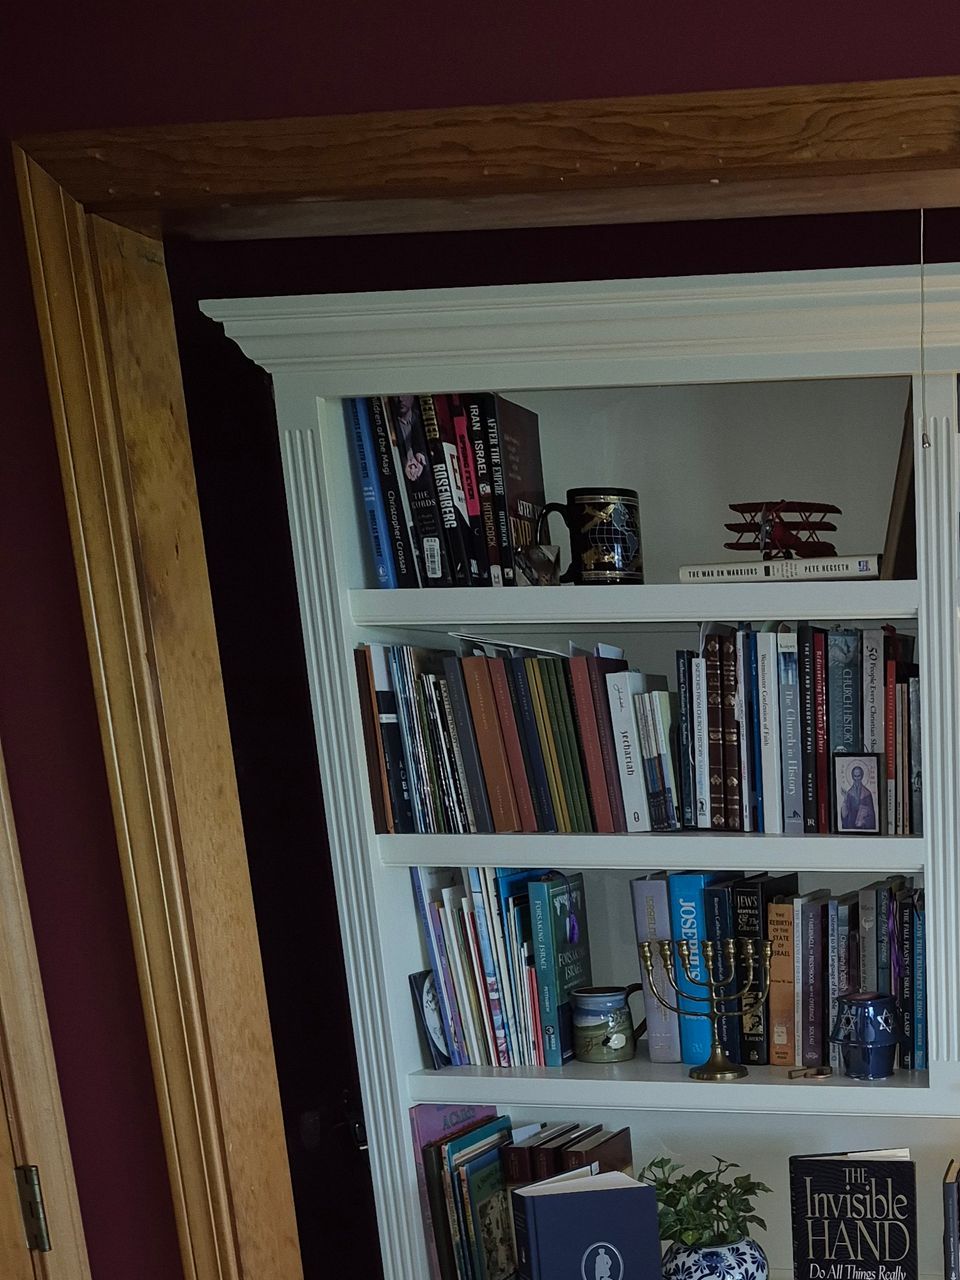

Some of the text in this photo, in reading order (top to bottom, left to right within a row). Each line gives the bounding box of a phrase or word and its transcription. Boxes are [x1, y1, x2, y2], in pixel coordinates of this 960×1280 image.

[469, 405, 487, 477] IRAN ISRAEL
[486, 416, 504, 496] AFTER THE EMPIRE
[432, 463, 457, 529] ROSENBERG
[387, 491, 407, 574] Christopher Crossan
[483, 502, 495, 548] HITCHCOCK
[702, 570, 714, 578] WAR
[726, 568, 758, 577] WARRIORS
[804, 565, 820, 573] PETE
[822, 563, 849, 572] HEGSETH
[760, 654, 770, 747] Westminster Confession of Faith
[815, 651, 825, 753] Rediscovering Church Fathers
[842, 669, 854, 745] CHURCH HISTORY
[866, 646, 878, 736] 50 People Every Christian
[785, 690, 800, 796] The Church in History
[714, 916, 722, 939] Catholics
[737, 895, 757, 907] JEWS
[534, 900, 547, 970] FORSAKING ISRAEL
[773, 934, 789, 942] STATE
[804, 1176, 908, 1220] Invisible
[842, 1167, 868, 1184] THE
[806, 1218, 910, 1262] HAND
[809, 1263, 825, 1279] Do
[826, 1263, 843, 1280] All
